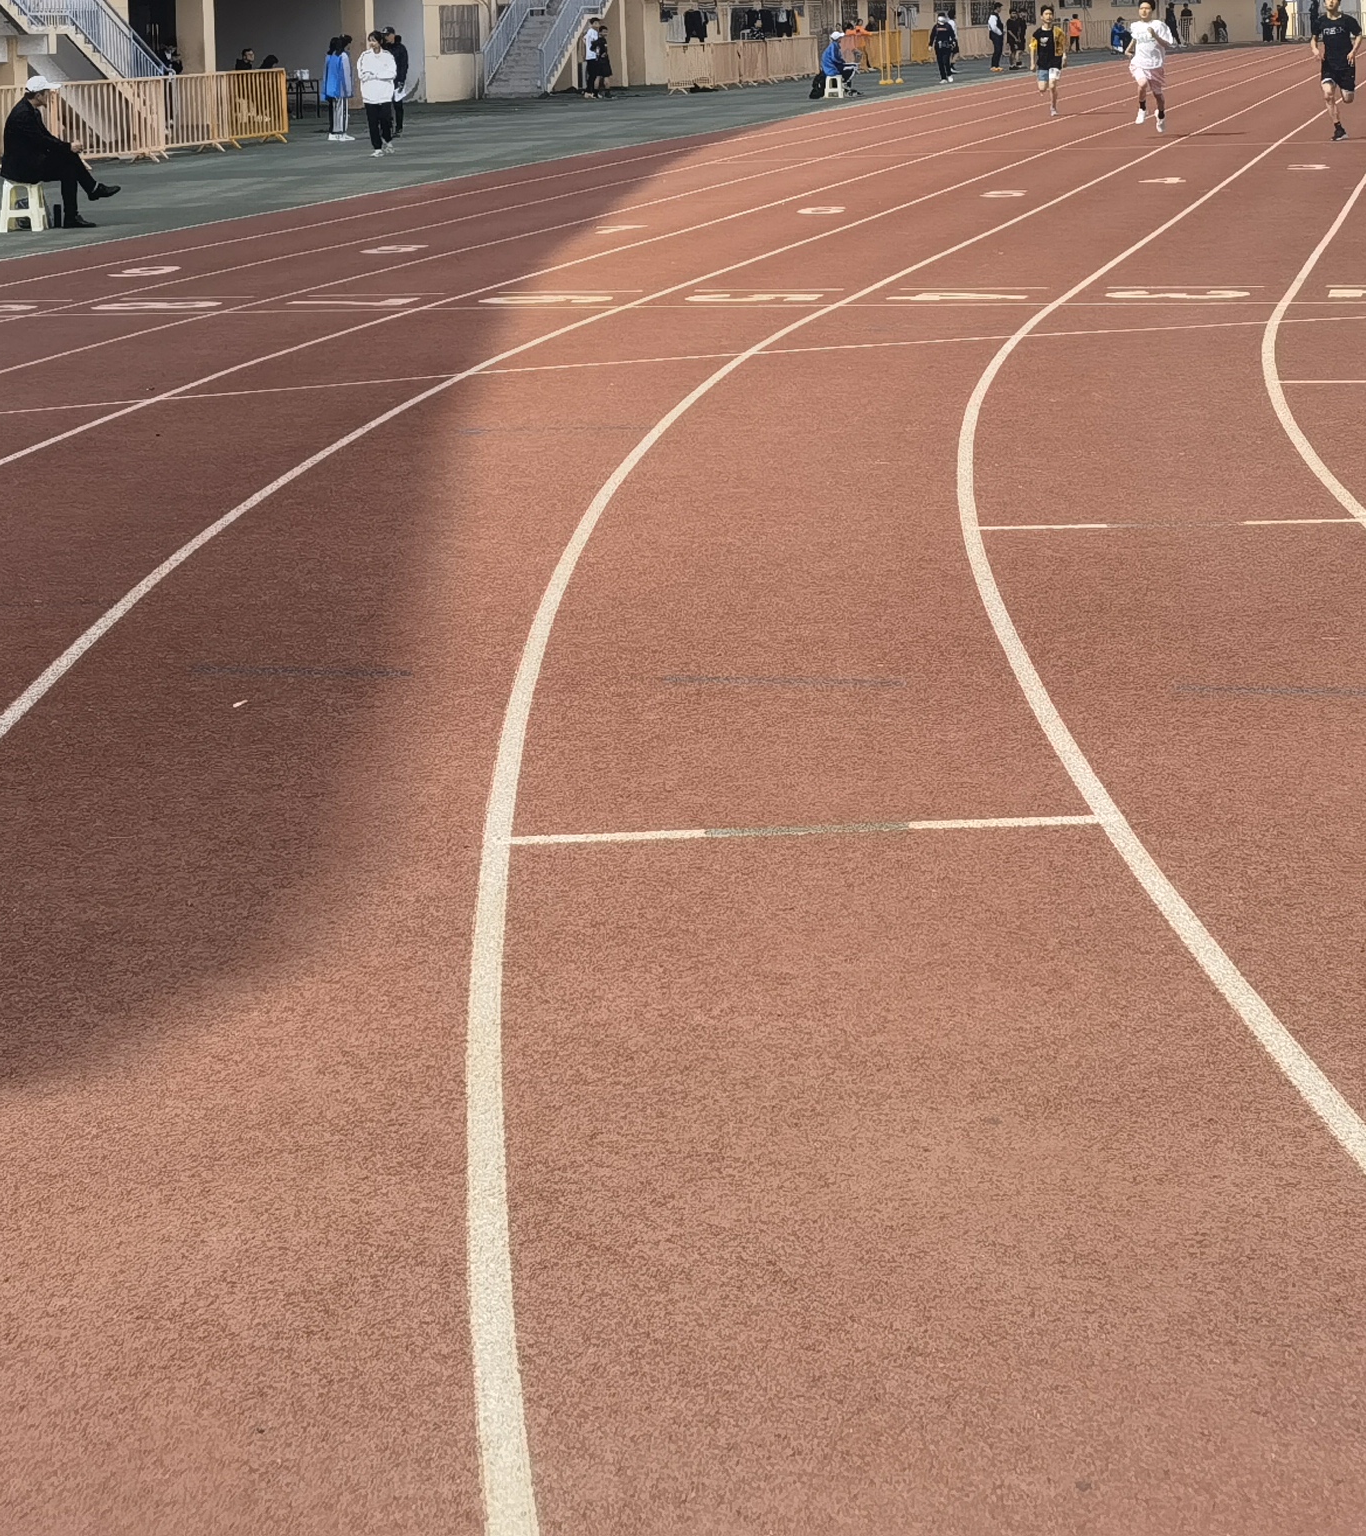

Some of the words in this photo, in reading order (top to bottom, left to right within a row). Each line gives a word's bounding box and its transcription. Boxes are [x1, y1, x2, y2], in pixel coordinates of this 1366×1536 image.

[796, 206, 847, 215] 6
[886, 292, 1028, 301] 4
[1105, 290, 1252, 299] 3
